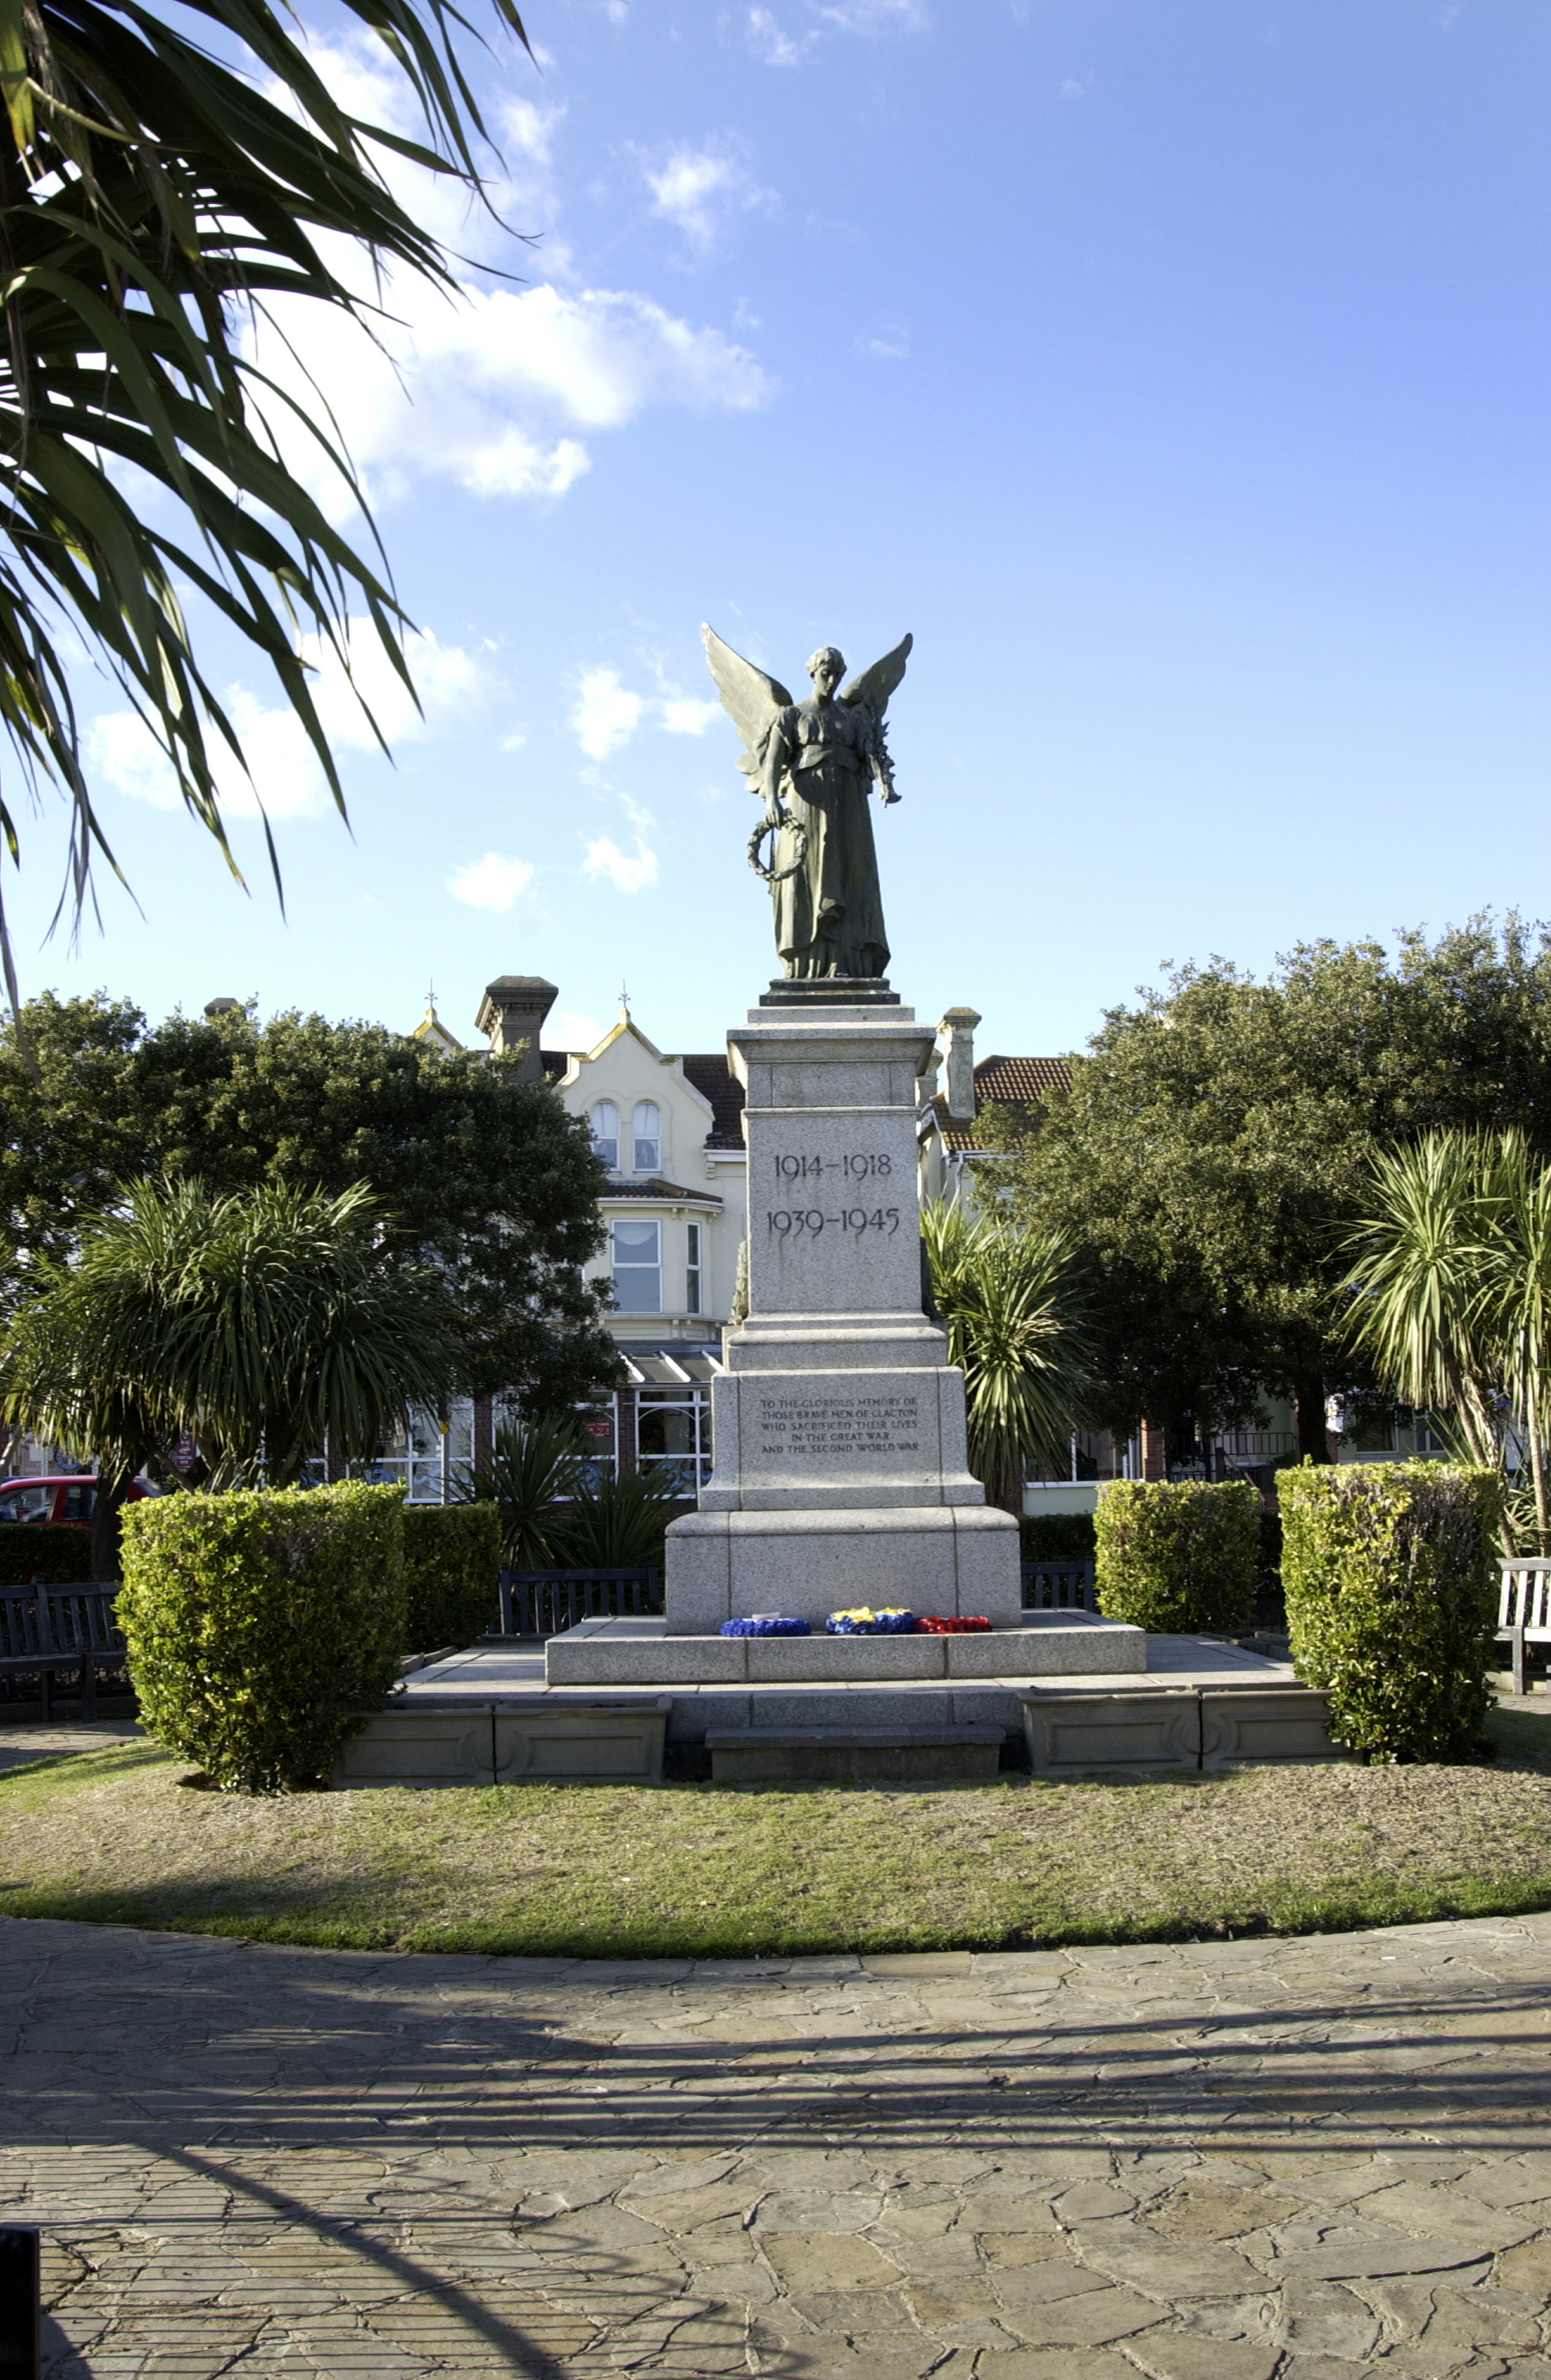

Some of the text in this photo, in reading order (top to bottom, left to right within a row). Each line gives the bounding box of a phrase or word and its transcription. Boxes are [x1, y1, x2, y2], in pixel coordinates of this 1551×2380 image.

[775, 1154, 892, 1181] 1914-1918
[767, 1208, 899, 1237] 1939-1945
[761, 1397, 917, 1408] TO THE GLORIOUS MEMORY OF
[762, 1408, 918, 1420] THOSE BRAVE MEN OF CLACTON
[761, 1419, 918, 1431] WHO SACRIFICED THEIR LIVES
[791, 1431, 889, 1442] IN THE GREAT WAR
[761, 1442, 919, 1454] AND THE SECOND WORLD WAR
